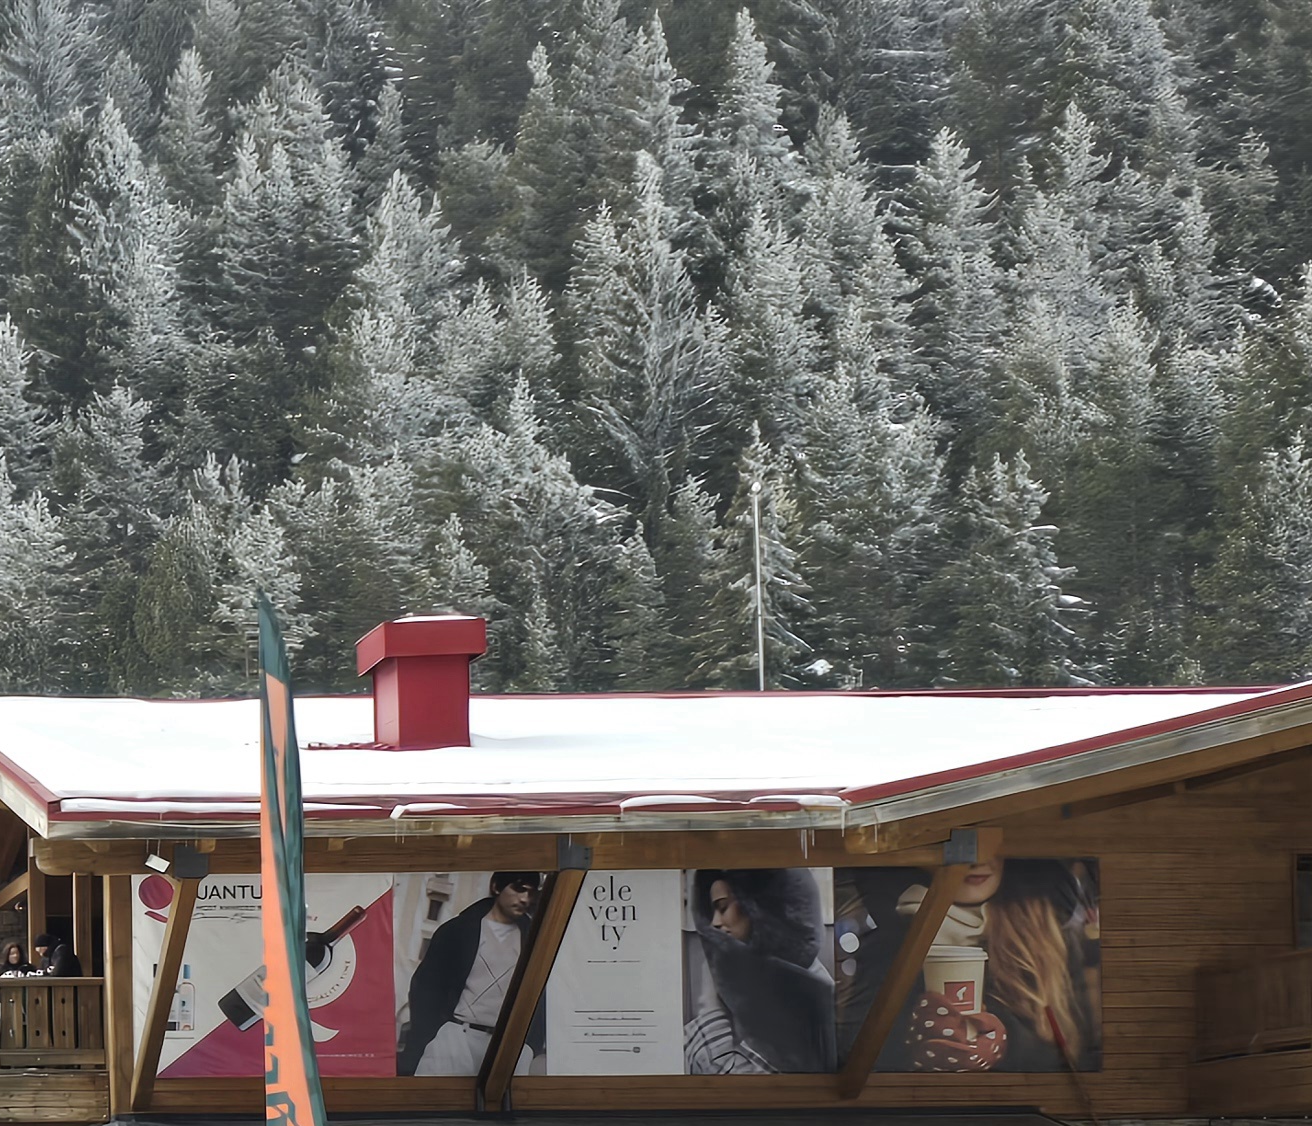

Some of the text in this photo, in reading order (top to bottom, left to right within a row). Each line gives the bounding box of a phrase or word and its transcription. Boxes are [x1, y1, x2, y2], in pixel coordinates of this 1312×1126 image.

[197, 885, 263, 900] UANTU
[593, 875, 633, 902] ele
[587, 904, 638, 922] ven
[600, 924, 627, 950] ty
